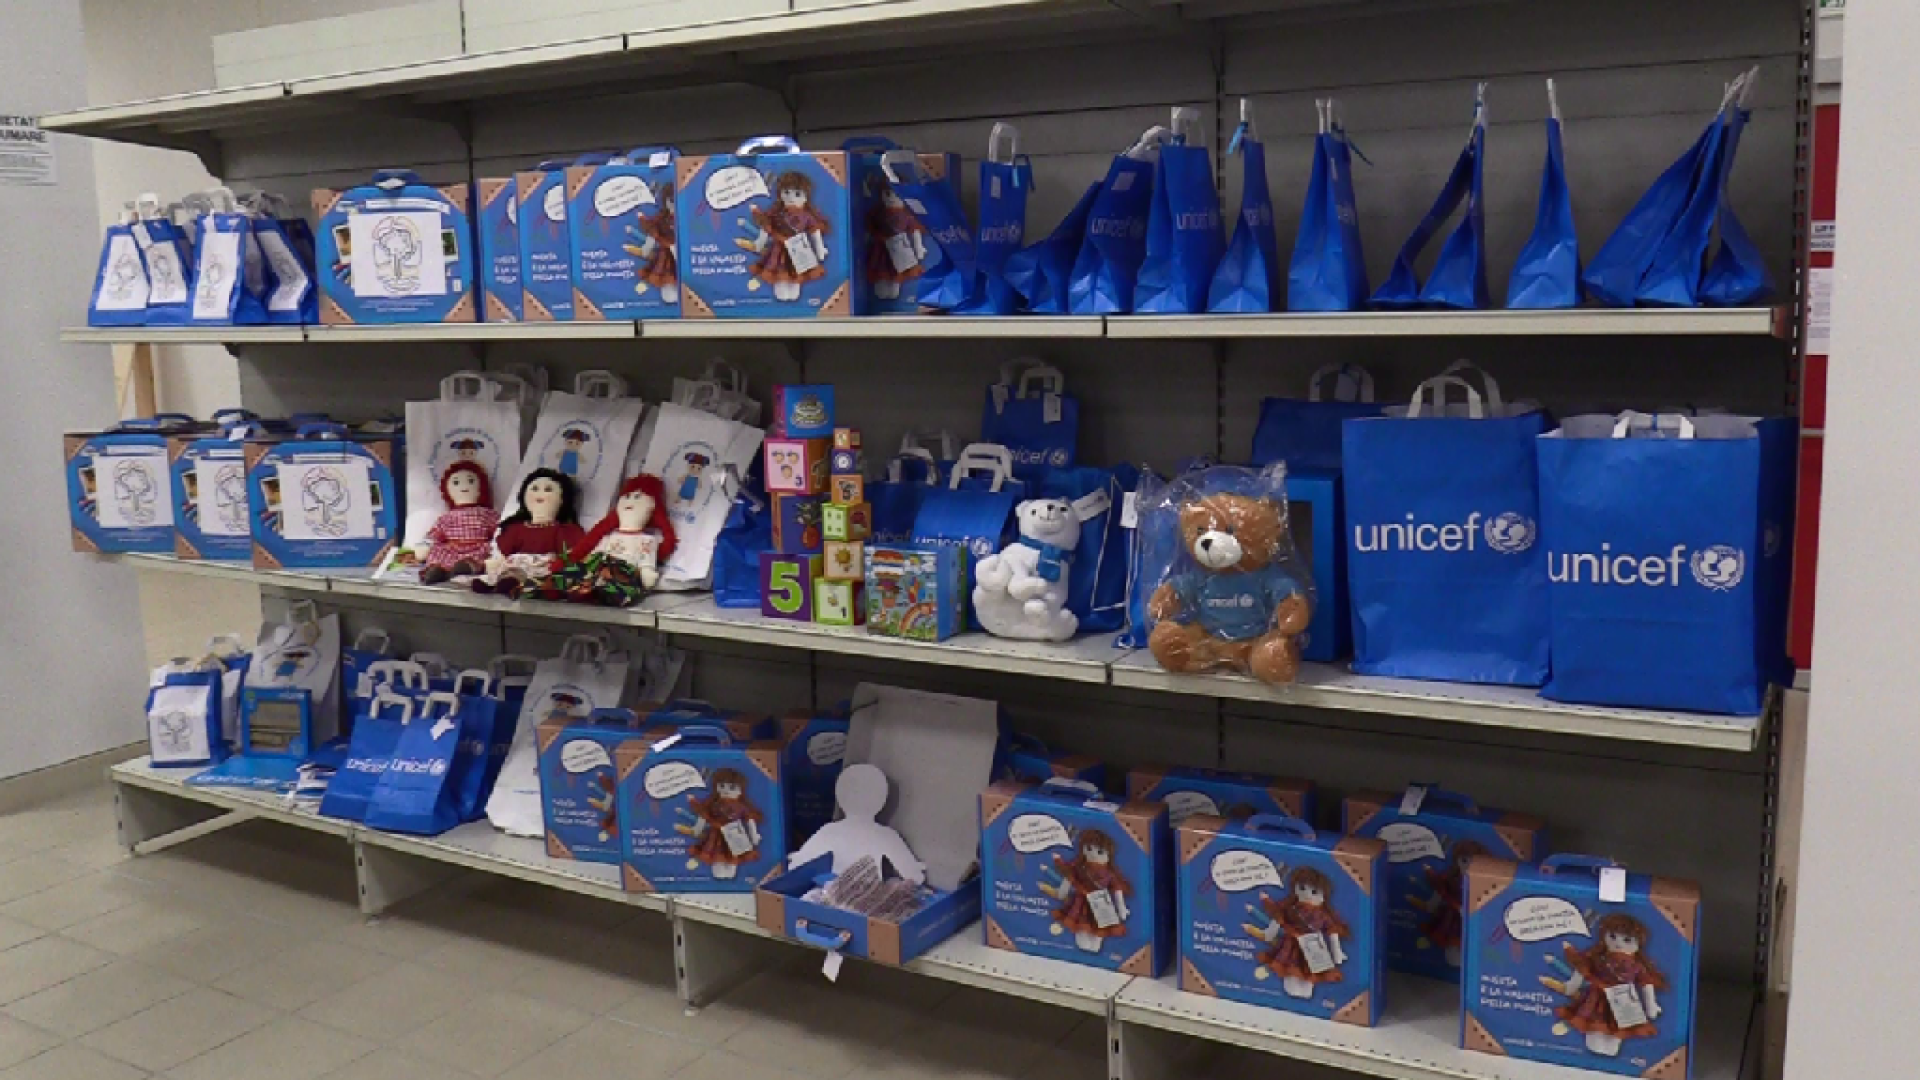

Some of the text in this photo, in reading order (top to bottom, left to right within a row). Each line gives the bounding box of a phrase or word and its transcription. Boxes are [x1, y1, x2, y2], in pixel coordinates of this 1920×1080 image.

[1008, 445, 1051, 464] nicef
[795, 476, 803, 486] 3
[1355, 511, 1481, 551] unicef
[1548, 542, 1686, 586] unicef
[768, 561, 803, 613] 5
[840, 606, 847, 618] 1
[390, 757, 434, 773] unicef
